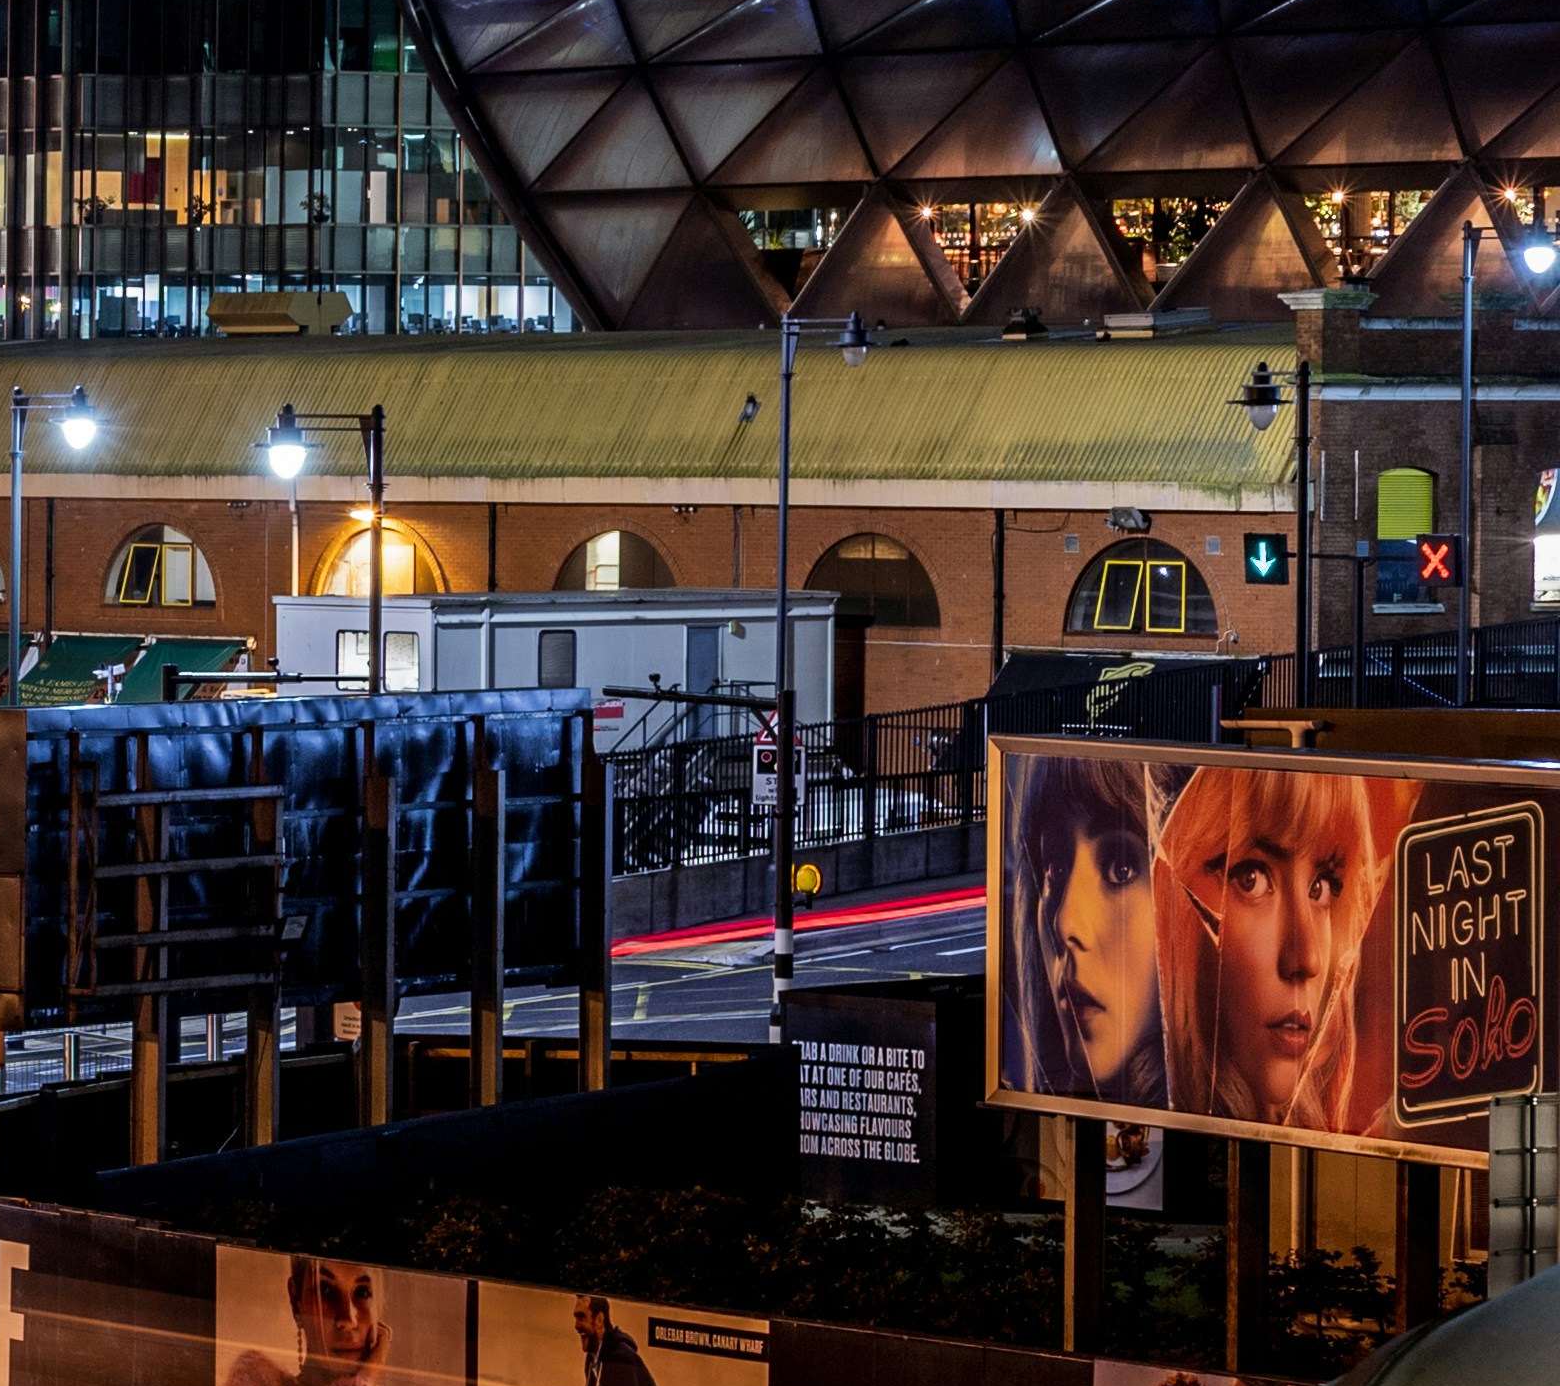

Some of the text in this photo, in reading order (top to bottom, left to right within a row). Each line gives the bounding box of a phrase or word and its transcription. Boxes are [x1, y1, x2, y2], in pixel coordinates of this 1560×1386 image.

[1425, 834, 1515, 895] LAST
[1412, 889, 1527, 955] NIGHT
[1451, 951, 1485, 1004] IN
[792, 1040, 925, 1070] RAB A DRINK OR A BITE TO
[812, 1066, 825, 1085] AT
[827, 1066, 847, 1086] ONE
[849, 1068, 862, 1087] OF
[864, 1069, 884, 1090] OUR
[820, 1089, 840, 1109] AND
[842, 1091, 917, 1118] RESTAURANTS,
[800, 1110, 912, 1139] HOWCASING FLAVOURS
[800, 1134, 920, 1163] ROM ACROSS THE GLOBE.
[712, 1334, 738, 1351] CANARY
